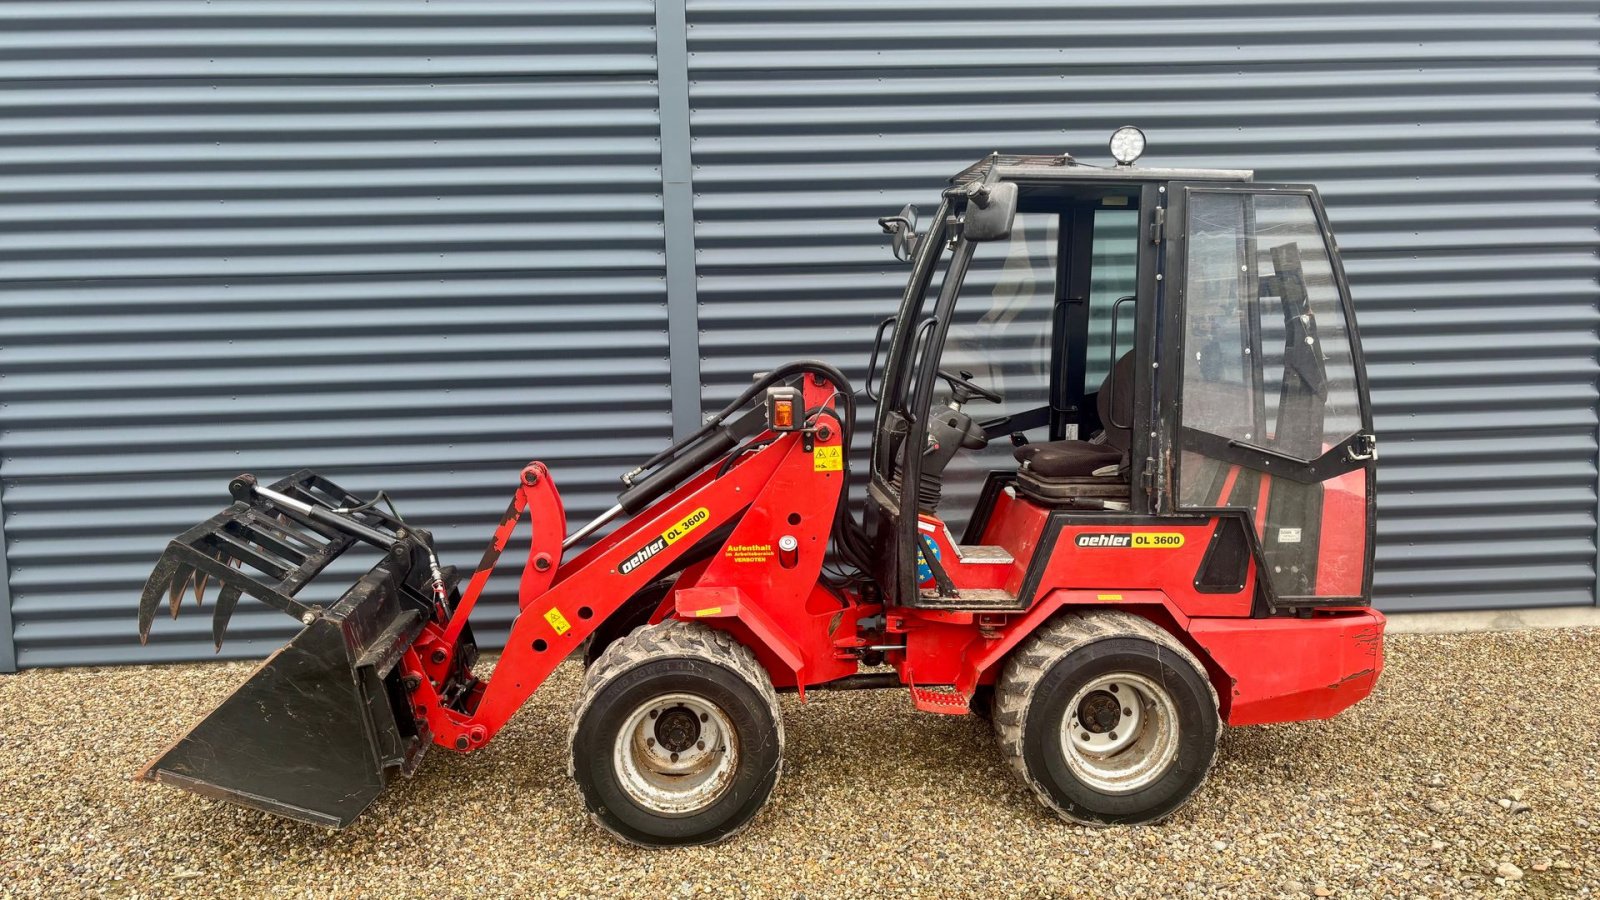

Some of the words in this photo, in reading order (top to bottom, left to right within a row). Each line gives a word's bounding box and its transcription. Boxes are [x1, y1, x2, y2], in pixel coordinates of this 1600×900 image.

[622, 538, 663, 574] oehler
[667, 529, 682, 540] OL
[681, 511, 706, 530] 3600
[1078, 534, 1131, 546] oehler
[1135, 536, 1150, 545] OL
[1153, 536, 1180, 545] 3600
